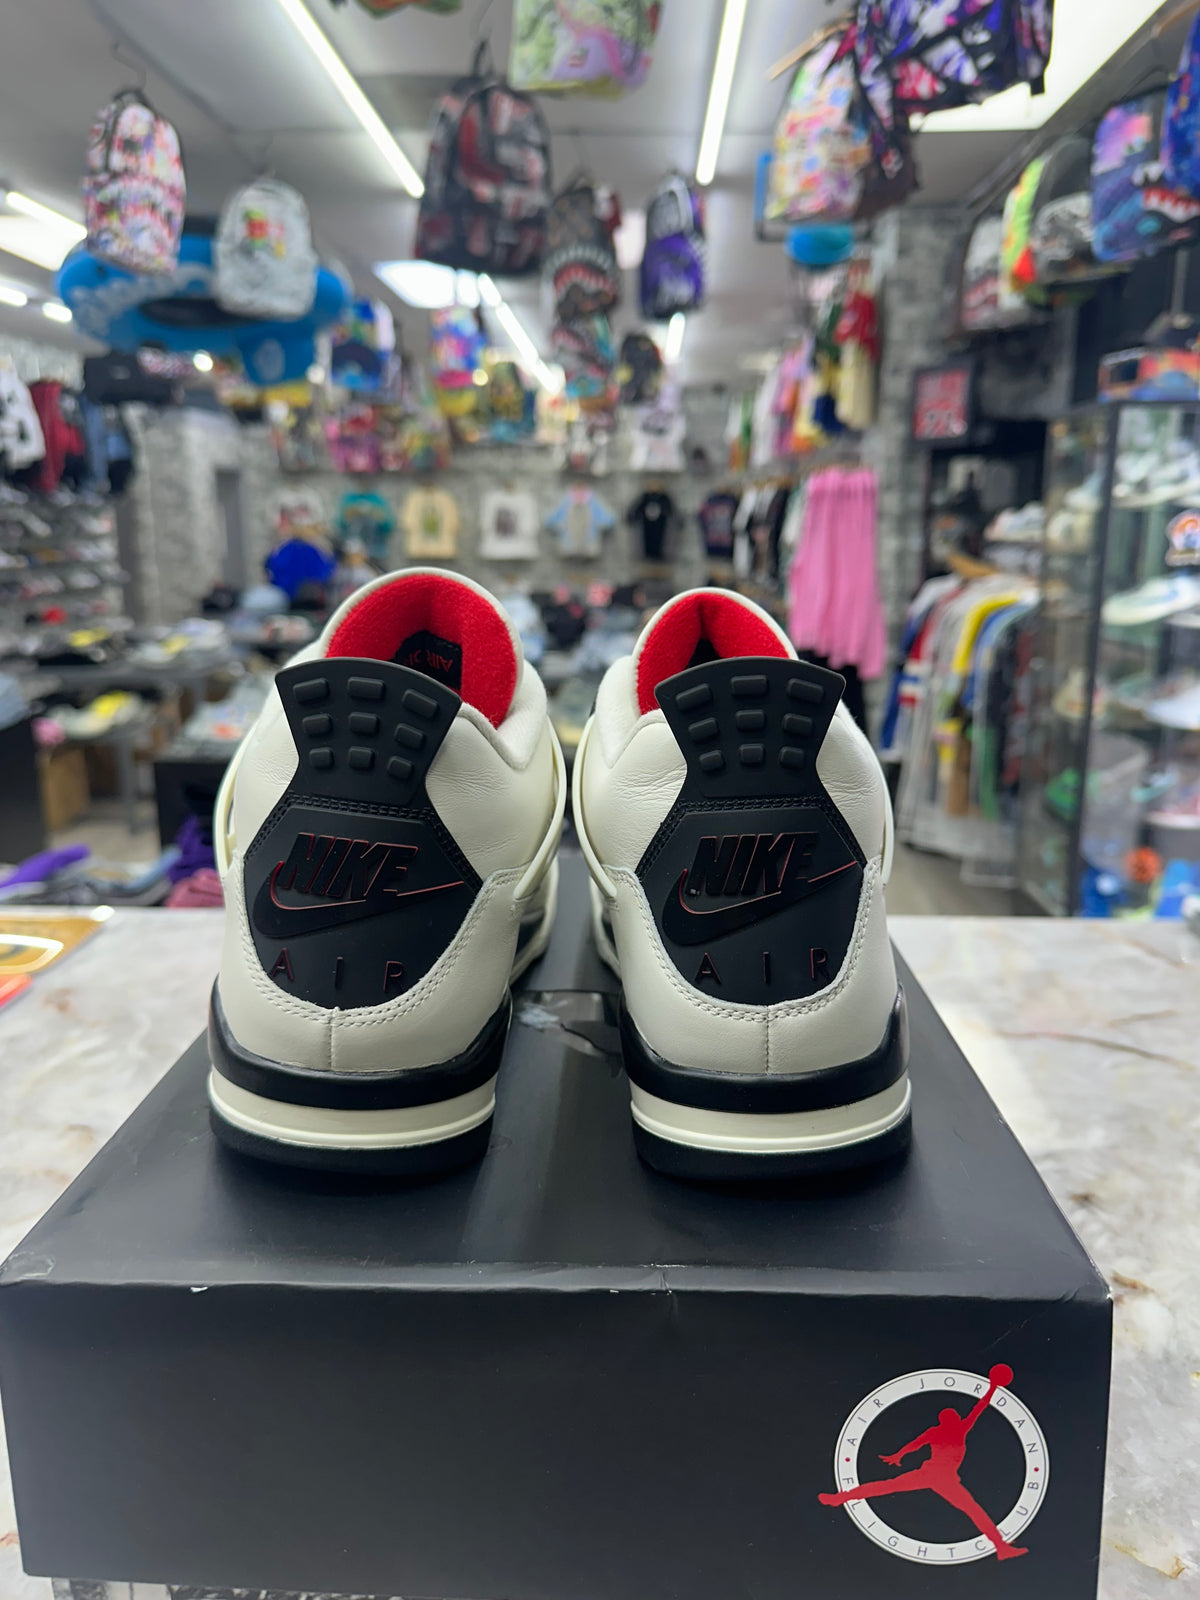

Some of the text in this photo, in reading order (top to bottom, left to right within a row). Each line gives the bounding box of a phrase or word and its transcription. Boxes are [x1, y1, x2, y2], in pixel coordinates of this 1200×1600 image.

[276, 832, 419, 897] NIKE
[687, 831, 820, 897] NIKE
[270, 947, 407, 994] AIR
[695, 947, 831, 985] AIR
[847, 1376, 1040, 1454] AIR JORDAN
